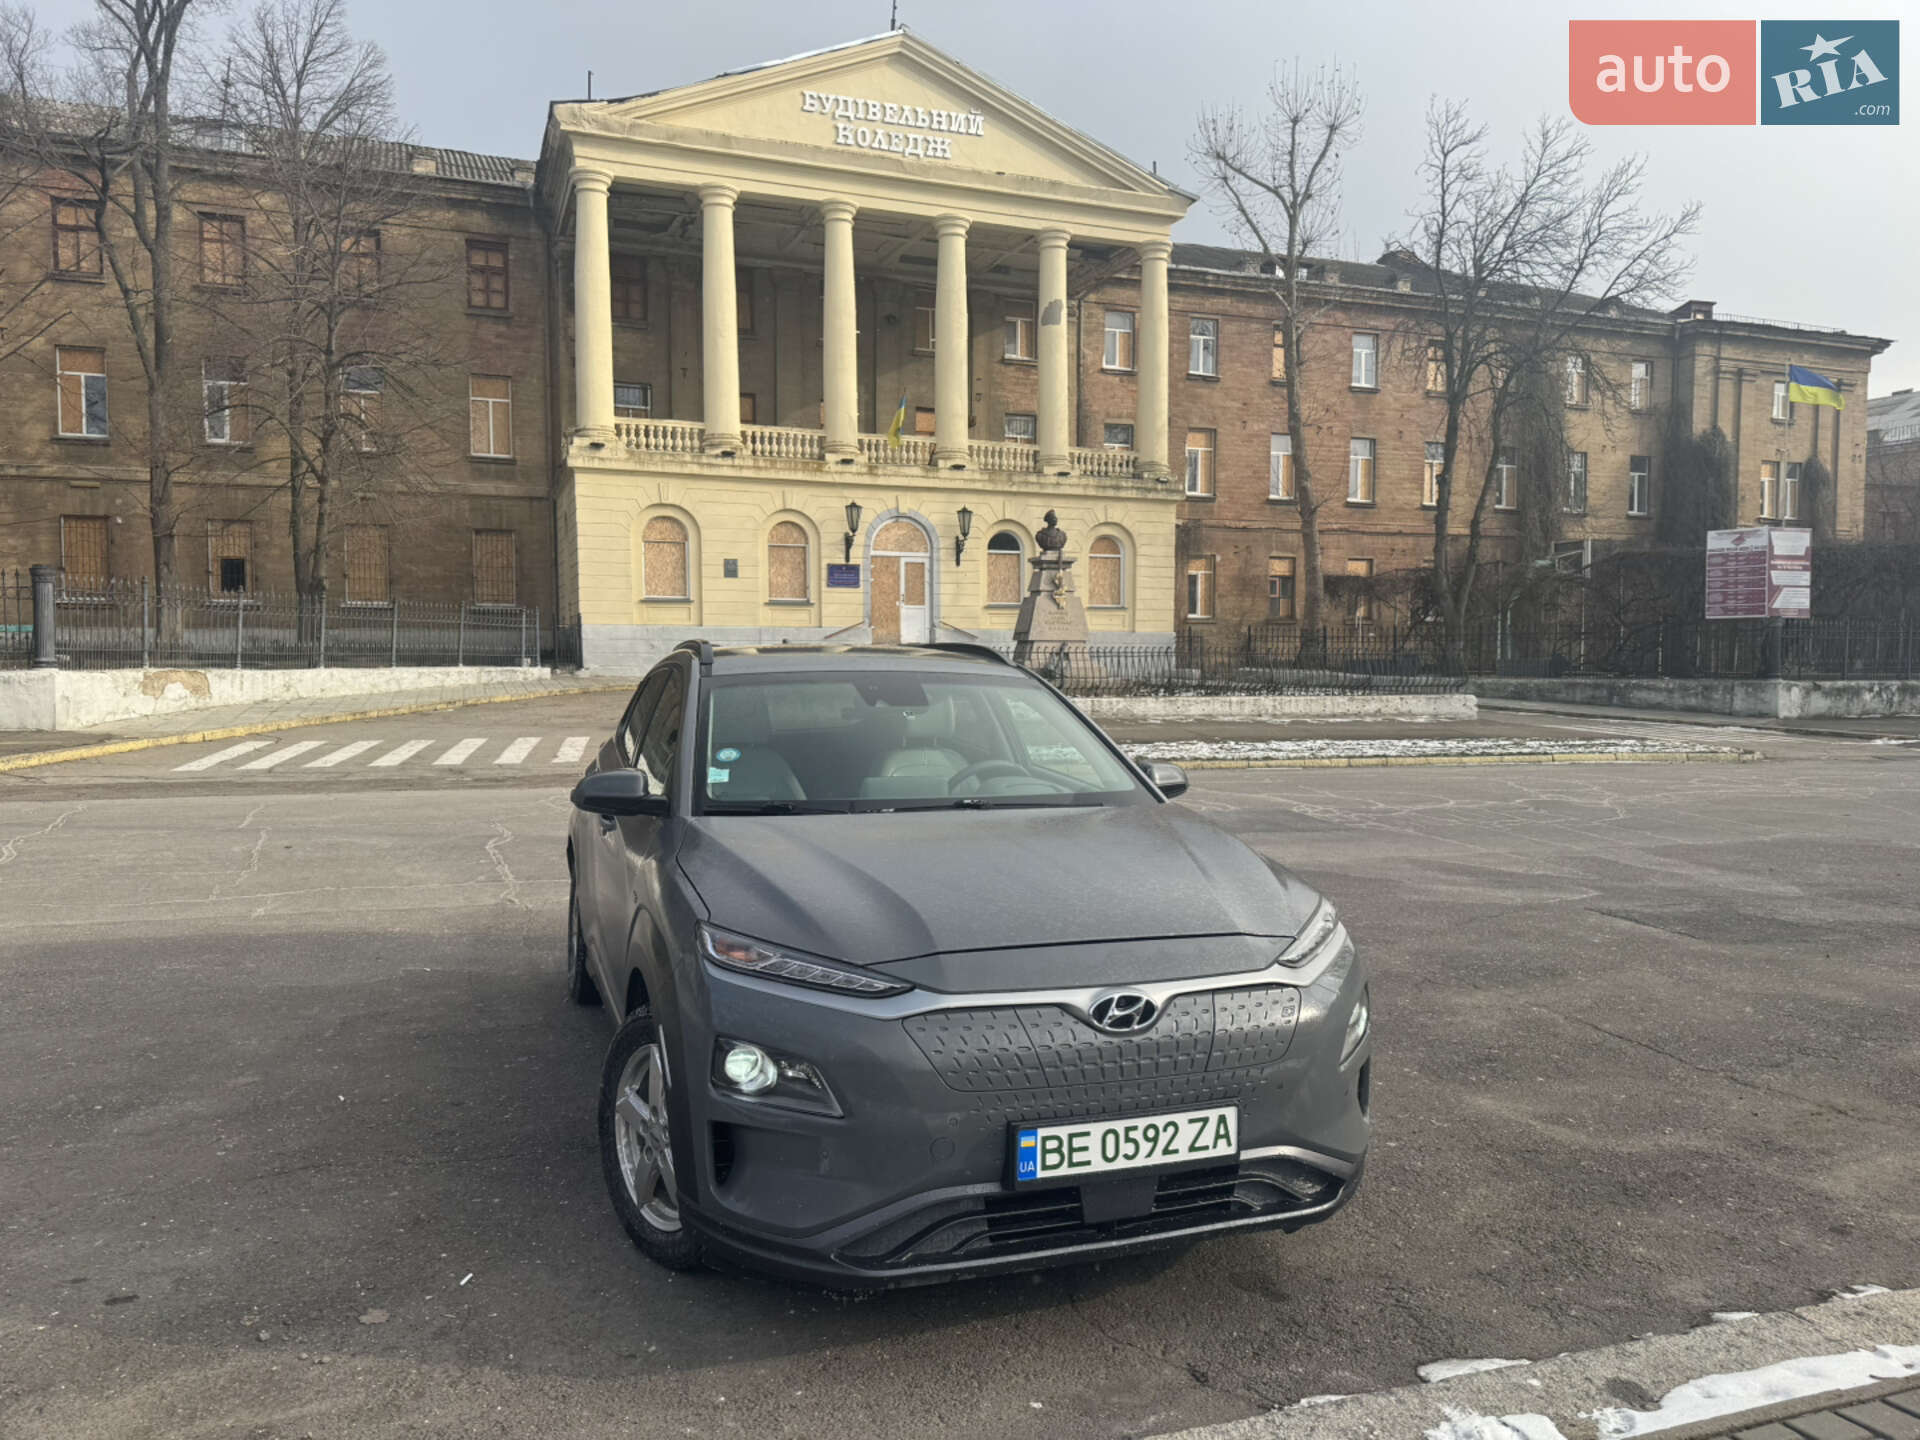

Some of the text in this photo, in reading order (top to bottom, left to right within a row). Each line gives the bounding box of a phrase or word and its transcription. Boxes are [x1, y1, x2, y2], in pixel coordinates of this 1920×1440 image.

[802, 90, 985, 136] БУДІВЕЛЬНИЙ
[836, 123, 953, 160] КОЛЕДЖ
[1040, 1113, 1233, 1171] BE 0592 ZA
[1019, 1160, 1035, 1173] UA
